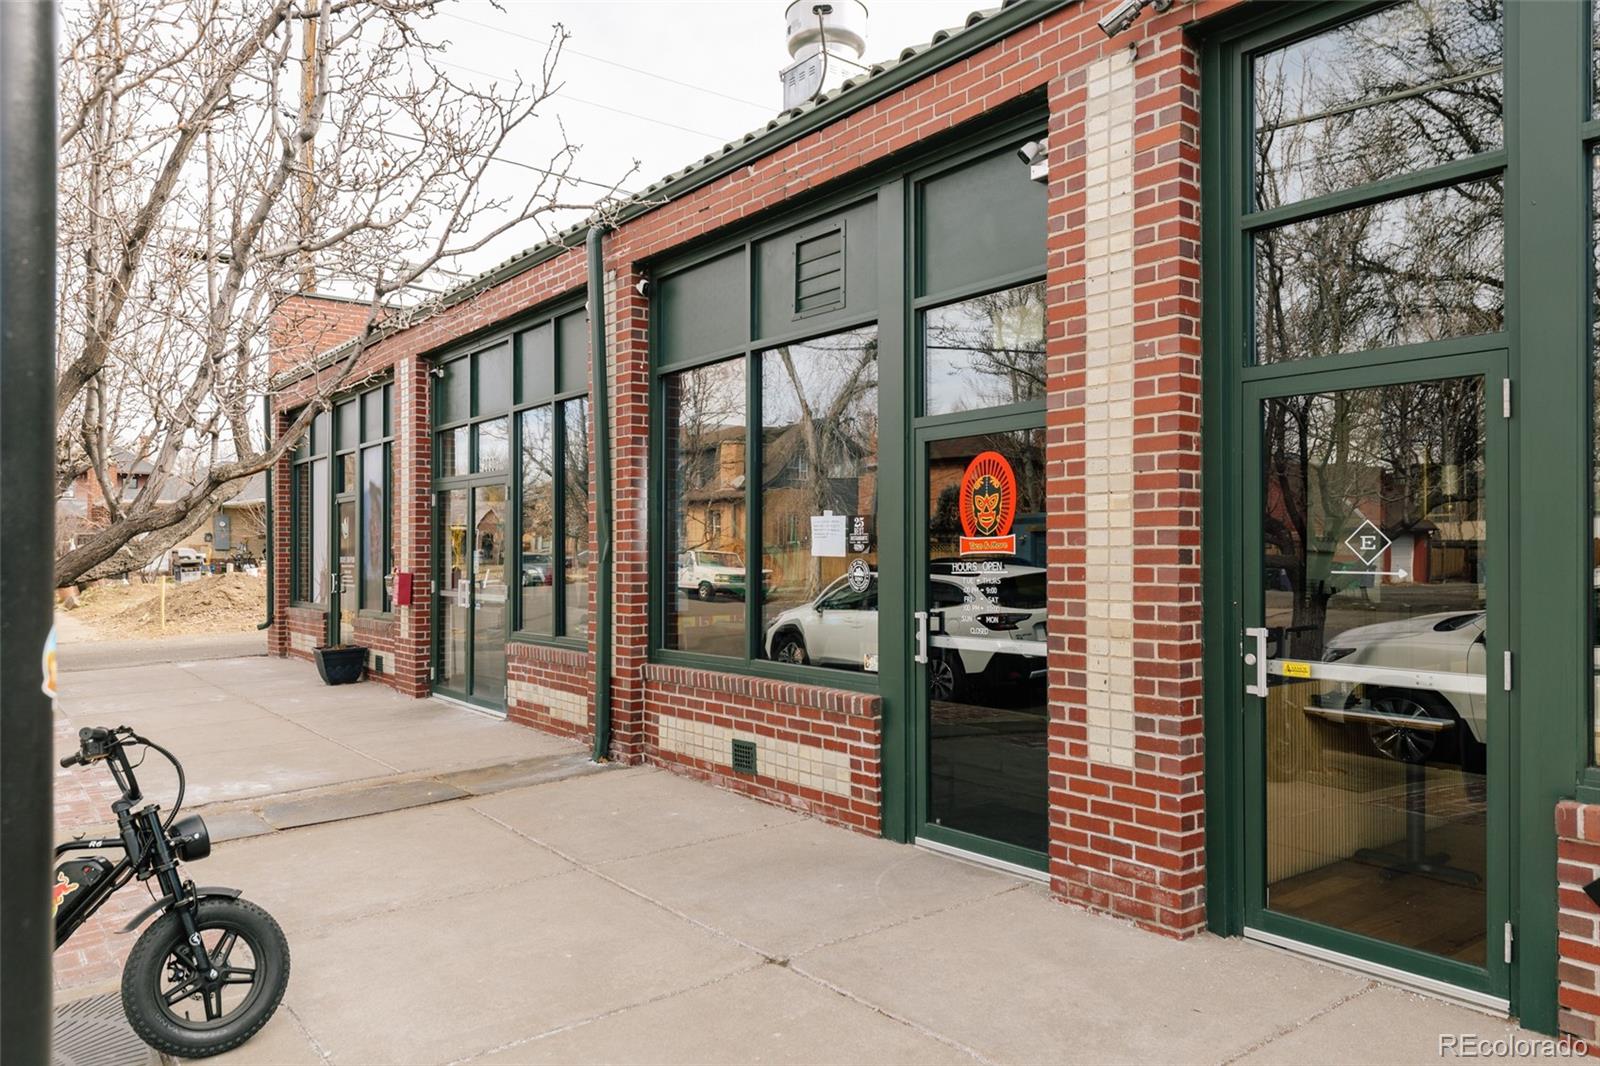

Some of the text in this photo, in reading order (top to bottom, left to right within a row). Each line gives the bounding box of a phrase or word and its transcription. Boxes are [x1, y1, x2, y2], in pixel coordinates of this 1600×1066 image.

[854, 516, 864, 528] 25
[1360, 535, 1376, 550] E
[952, 562, 1002, 572] HOURS OPEN
[985, 586, 998, 594] 9:00
[985, 616, 999, 624] MON
[88, 840, 103, 848] R6
